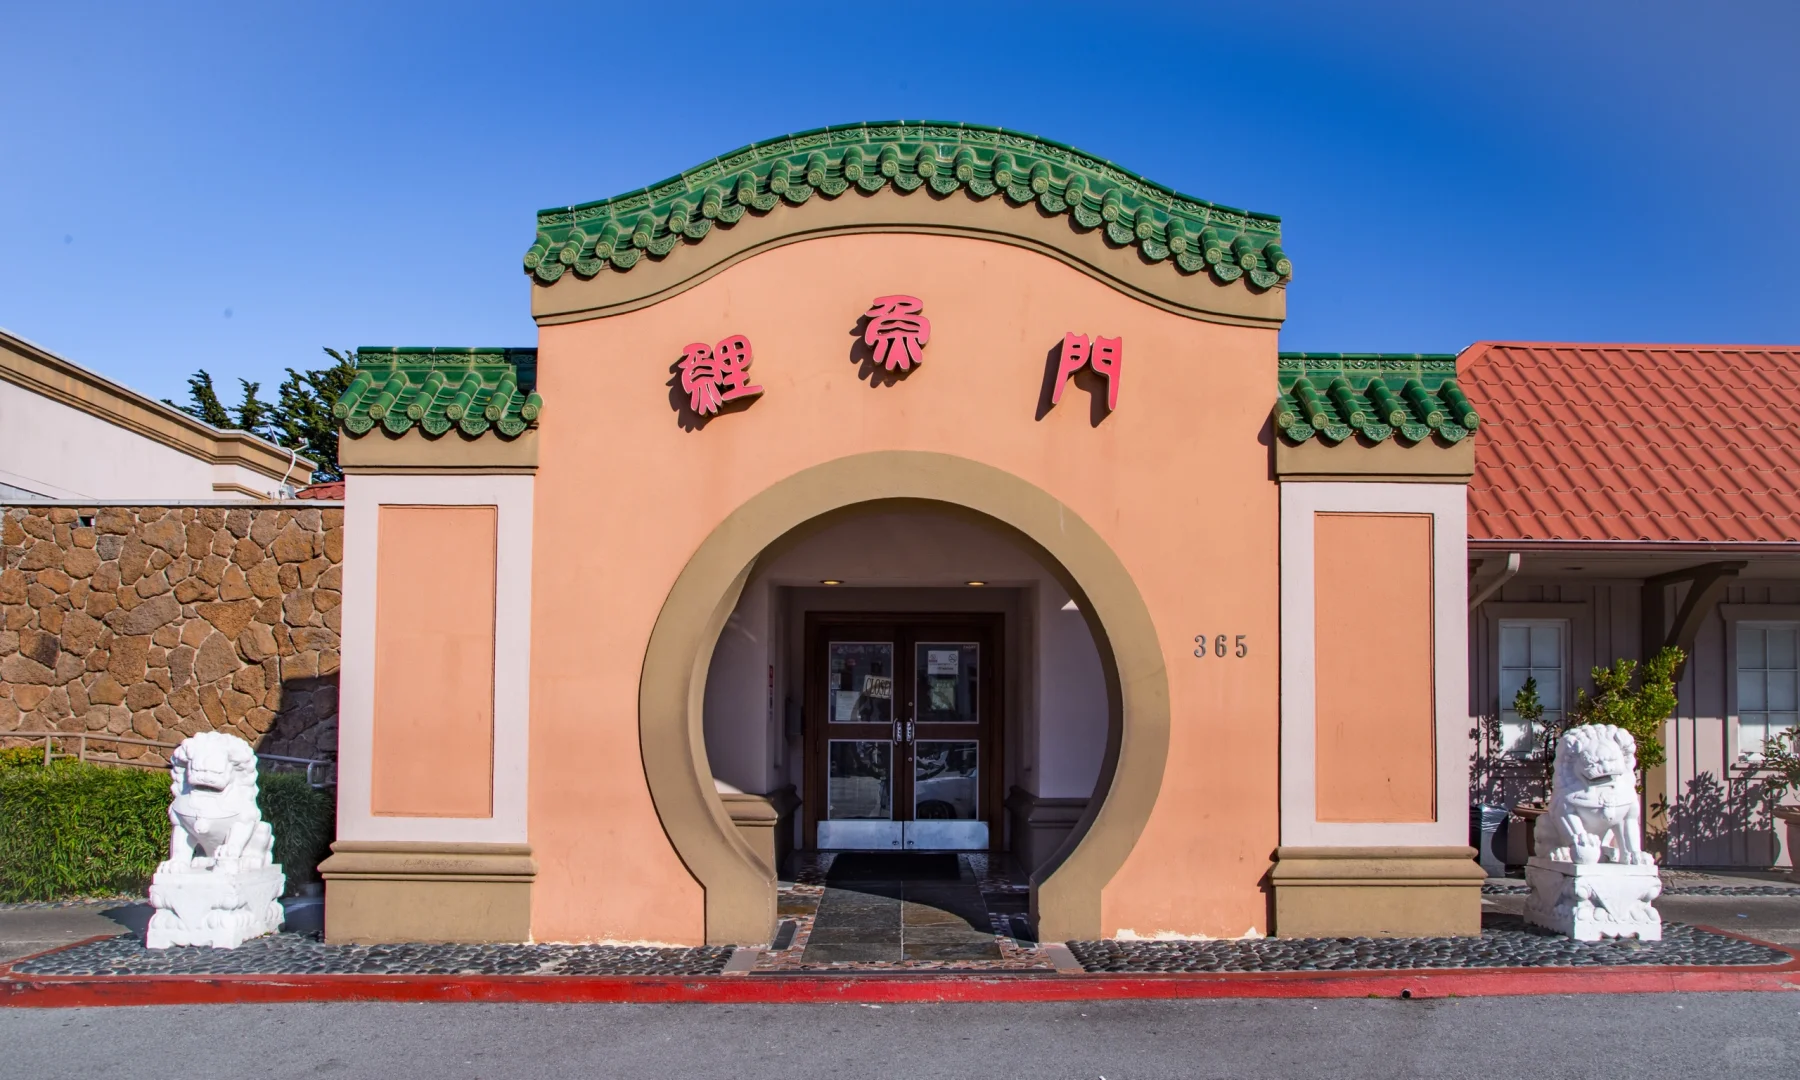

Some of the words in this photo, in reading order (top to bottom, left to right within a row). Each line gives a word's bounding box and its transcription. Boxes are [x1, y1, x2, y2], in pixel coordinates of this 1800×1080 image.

[681, 294, 1123, 415] 鯉魚門
[1193, 634, 1248, 658] 365
